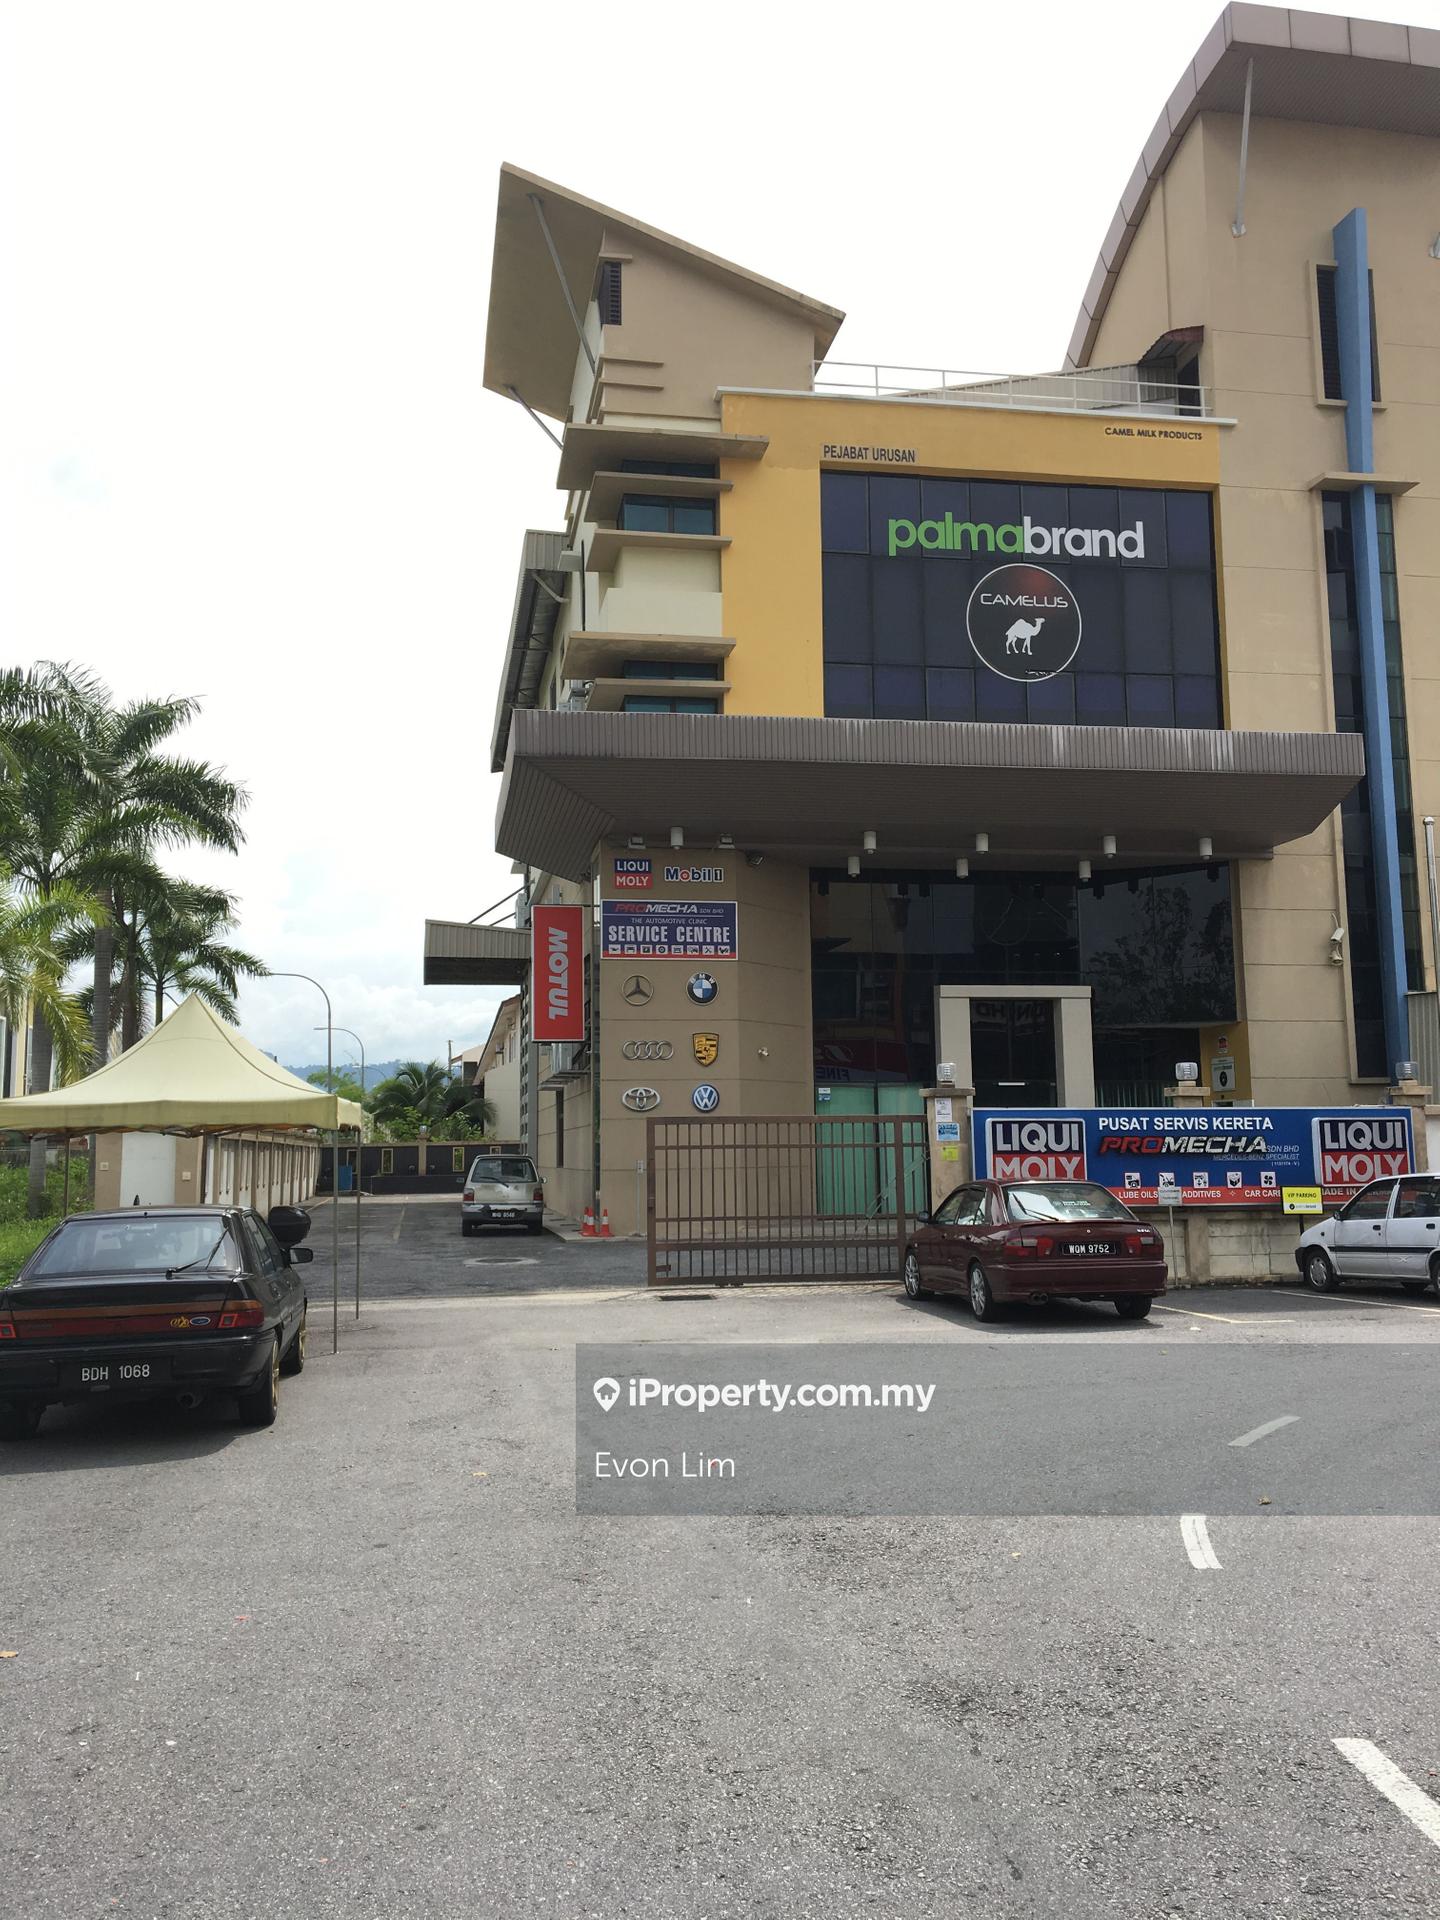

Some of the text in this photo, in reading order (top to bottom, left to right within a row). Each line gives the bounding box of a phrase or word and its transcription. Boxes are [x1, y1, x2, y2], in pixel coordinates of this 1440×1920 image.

[1105, 427, 1202, 440] CAMEL MILK PRODUCTS
[823, 445, 915, 462] PEJABAT URUSAN
[888, 511, 1145, 558] palmabrand
[980, 593, 1068, 609] CAMELUS
[616, 861, 649, 872] LIQUI
[665, 867, 712, 882] Mobil
[616, 876, 649, 887] MOLY
[615, 904, 698, 914] PROMECHA
[608, 925, 730, 943] SERVICE CENTRE
[548, 926, 569, 1020] MOTUL
[1099, 1117, 1274, 1131] PUSAT SERVIS KERETA
[995, 1122, 1080, 1153] LIQUI
[1099, 1135, 1300, 1154] PROMECHA SDN BHD
[1323, 1121, 1403, 1151] LIQUI
[995, 1156, 1081, 1181] MOLY
[1324, 1154, 1406, 1182] MOLY
[1118, 1191, 1139, 1199] LUBE
[1141, 1191, 1159, 1199] OILS
[1181, 1190, 1221, 1198] ADDITIVES
[1244, 1190, 1263, 1198] CAR
[1346, 1187, 1356, 1195] IN
[1088, 1244, 1109, 1253] 9752
[81, 1364, 150, 1382] BDH 1068
